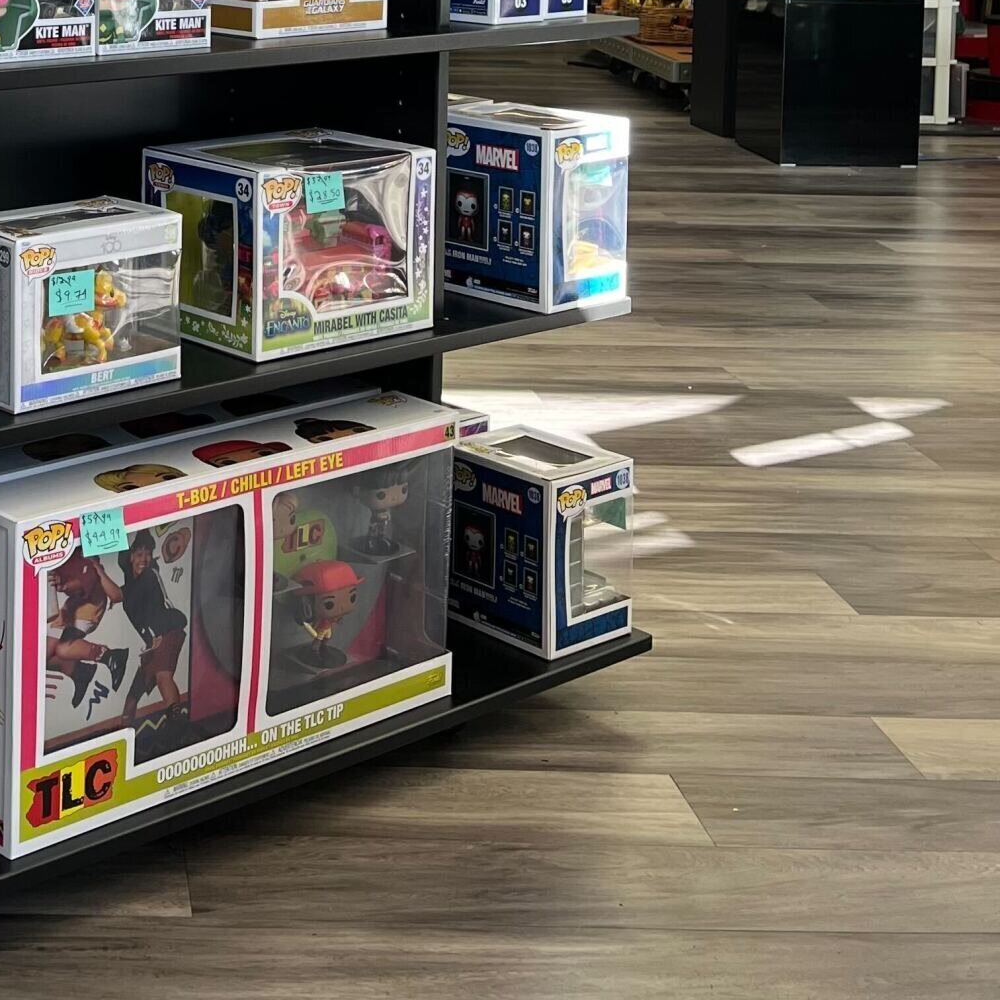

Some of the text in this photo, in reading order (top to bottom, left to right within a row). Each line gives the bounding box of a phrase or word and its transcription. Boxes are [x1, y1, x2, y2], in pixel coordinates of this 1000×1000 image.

[311, 3, 345, 15] GALAXY
[35, 27, 60, 40] KITE
[155, 19, 180, 31] KITE
[475, 144, 520, 172] MARVEL
[416, 161, 430, 175] 34
[236, 183, 250, 197] 34
[262, 177, 300, 207] POP!
[0, 251, 10, 265] 299
[18, 246, 57, 269] POP!
[55, 289, 87, 304] $9.74
[265, 317, 311, 336] ENCANTO
[313, 305, 409, 335] MIRABEL WITH CASITA
[91, 369, 115, 384] BERT
[444, 426, 456, 439] 43
[176, 452, 344, 509] T-BOZ CHILLI LEFT EYE
[590, 477, 612, 495] MARVEL
[482, 482, 523, 516] MARVEL
[557, 488, 587, 514] POP!
[22, 520, 74, 559] POP!
[84, 528, 121, 545] $44.99
[32, 551, 66, 565] ALBUMS
[261, 727, 278, 745] ON
[280, 719, 302, 739] THE
[304, 710, 325, 730] TLC
[327, 703, 344, 722] TIP
[35, 759, 113, 820] TLC
